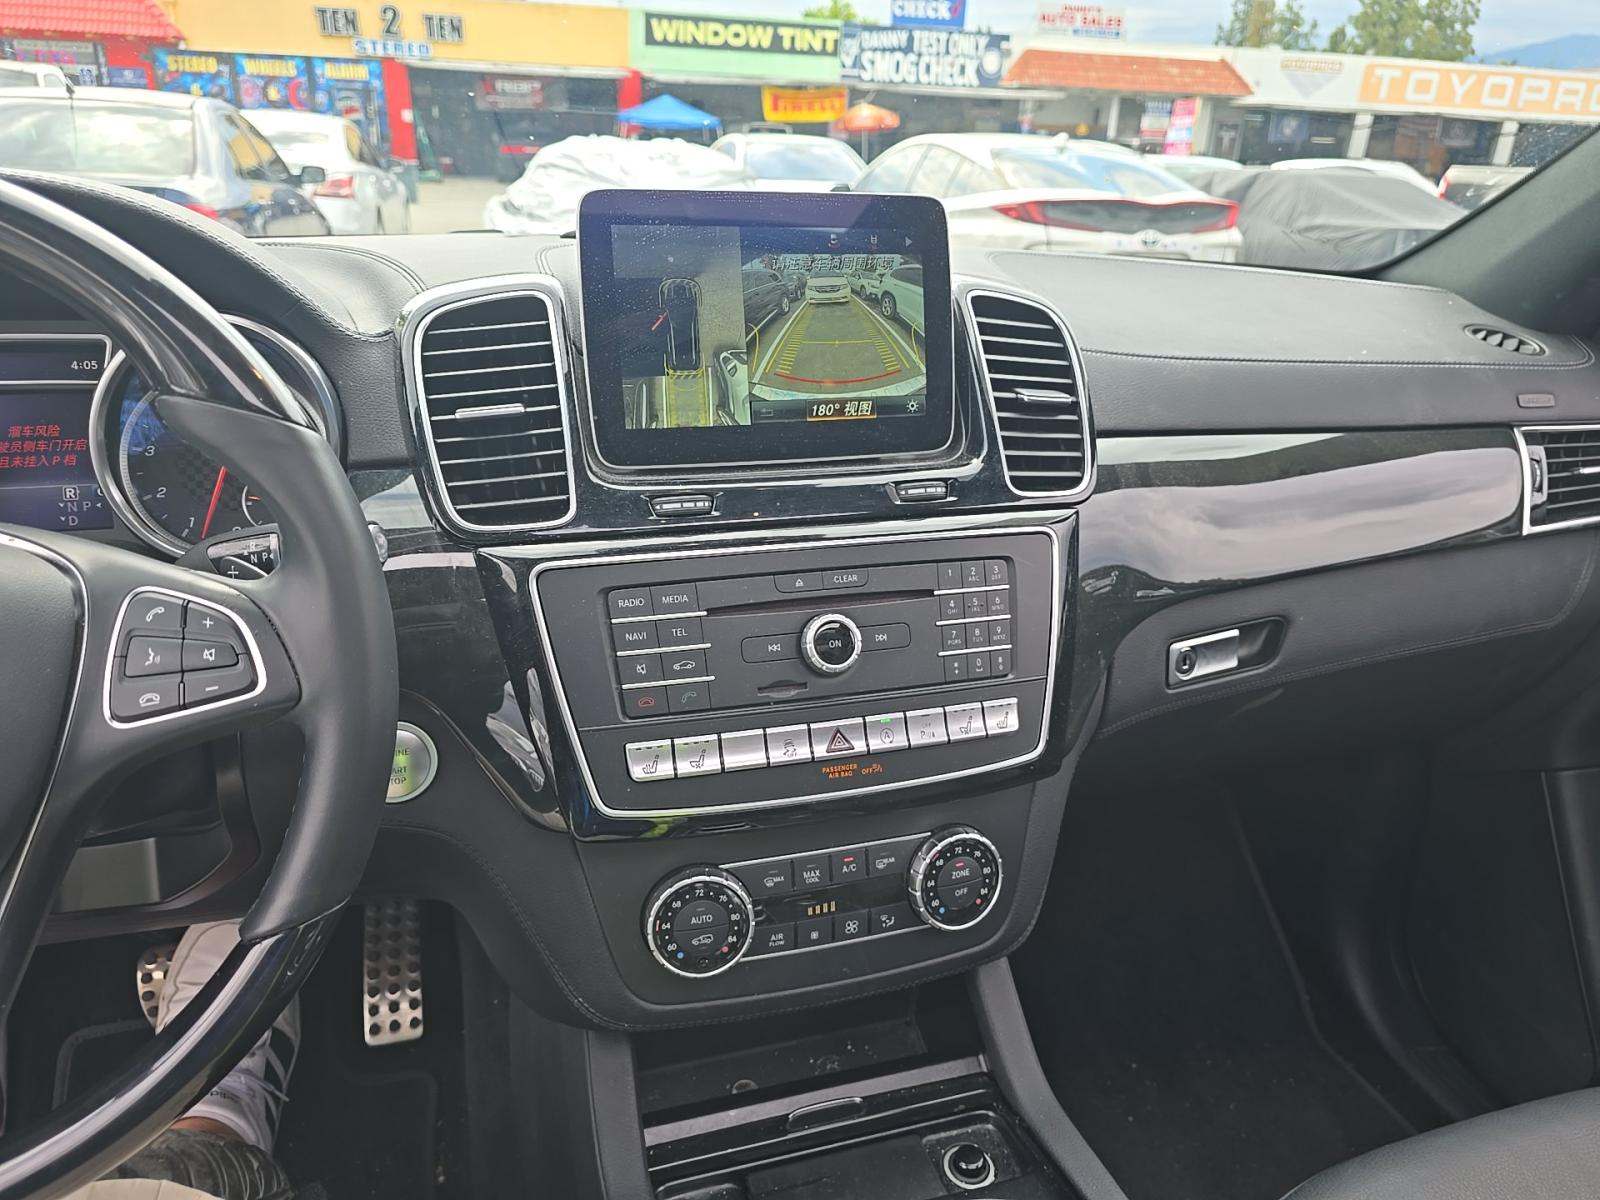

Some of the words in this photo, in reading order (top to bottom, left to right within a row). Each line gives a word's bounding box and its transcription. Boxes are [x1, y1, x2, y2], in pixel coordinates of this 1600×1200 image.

[316, 7, 360, 36] TEN
[381, 5, 401, 37] 2
[423, 14, 464, 42] TEN
[650, 17, 774, 49] WINDOW
[777, 26, 840, 53] TINT
[353, 39, 433, 58] STEREO
[912, 30, 949, 55] TEST
[949, 32, 990, 58] ONLY
[859, 50, 918, 83] SMOG
[918, 54, 980, 87] CHECK
[772, 254, 895, 271] 请注意车辆周围环境
[71, 360, 98, 370] 4:05
[812, 403, 840, 416] 180°
[844, 400, 872, 416] 视图
[145, 445, 155, 456] 3
[65, 488, 76, 498] R
[156, 487, 167, 498] 2
[67, 501, 77, 512] N
[83, 501, 91, 511] P
[69, 515, 78, 526] D
[188, 517, 195, 528] 1
[250, 554, 258, 563] N
[262, 552, 268, 562] P
[833, 573, 858, 583] CLEAR
[618, 597, 645, 608] RADIO
[661, 594, 689, 604] MEDIA
[625, 631, 647, 641] NAVI
[672, 628, 688, 637] TEL
[828, 639, 842, 648] ON
[822, 763, 858, 774] PASSENGER
[861, 767, 873, 775] OFF
[841, 770, 853, 778] BAG
[842, 864, 857, 873] A/C
[803, 869, 820, 879] MAX
[951, 869, 971, 879] ZONE
[695, 889, 704, 897] 72
[955, 888, 968, 897] OFF
[718, 895, 728, 903] 76
[931, 899, 939, 907] 60
[690, 914, 713, 925] AUTO
[731, 913, 740, 921] 80
[662, 922, 671, 930] 64
[770, 933, 784, 942] AIR
[667, 943, 677, 951] 60
